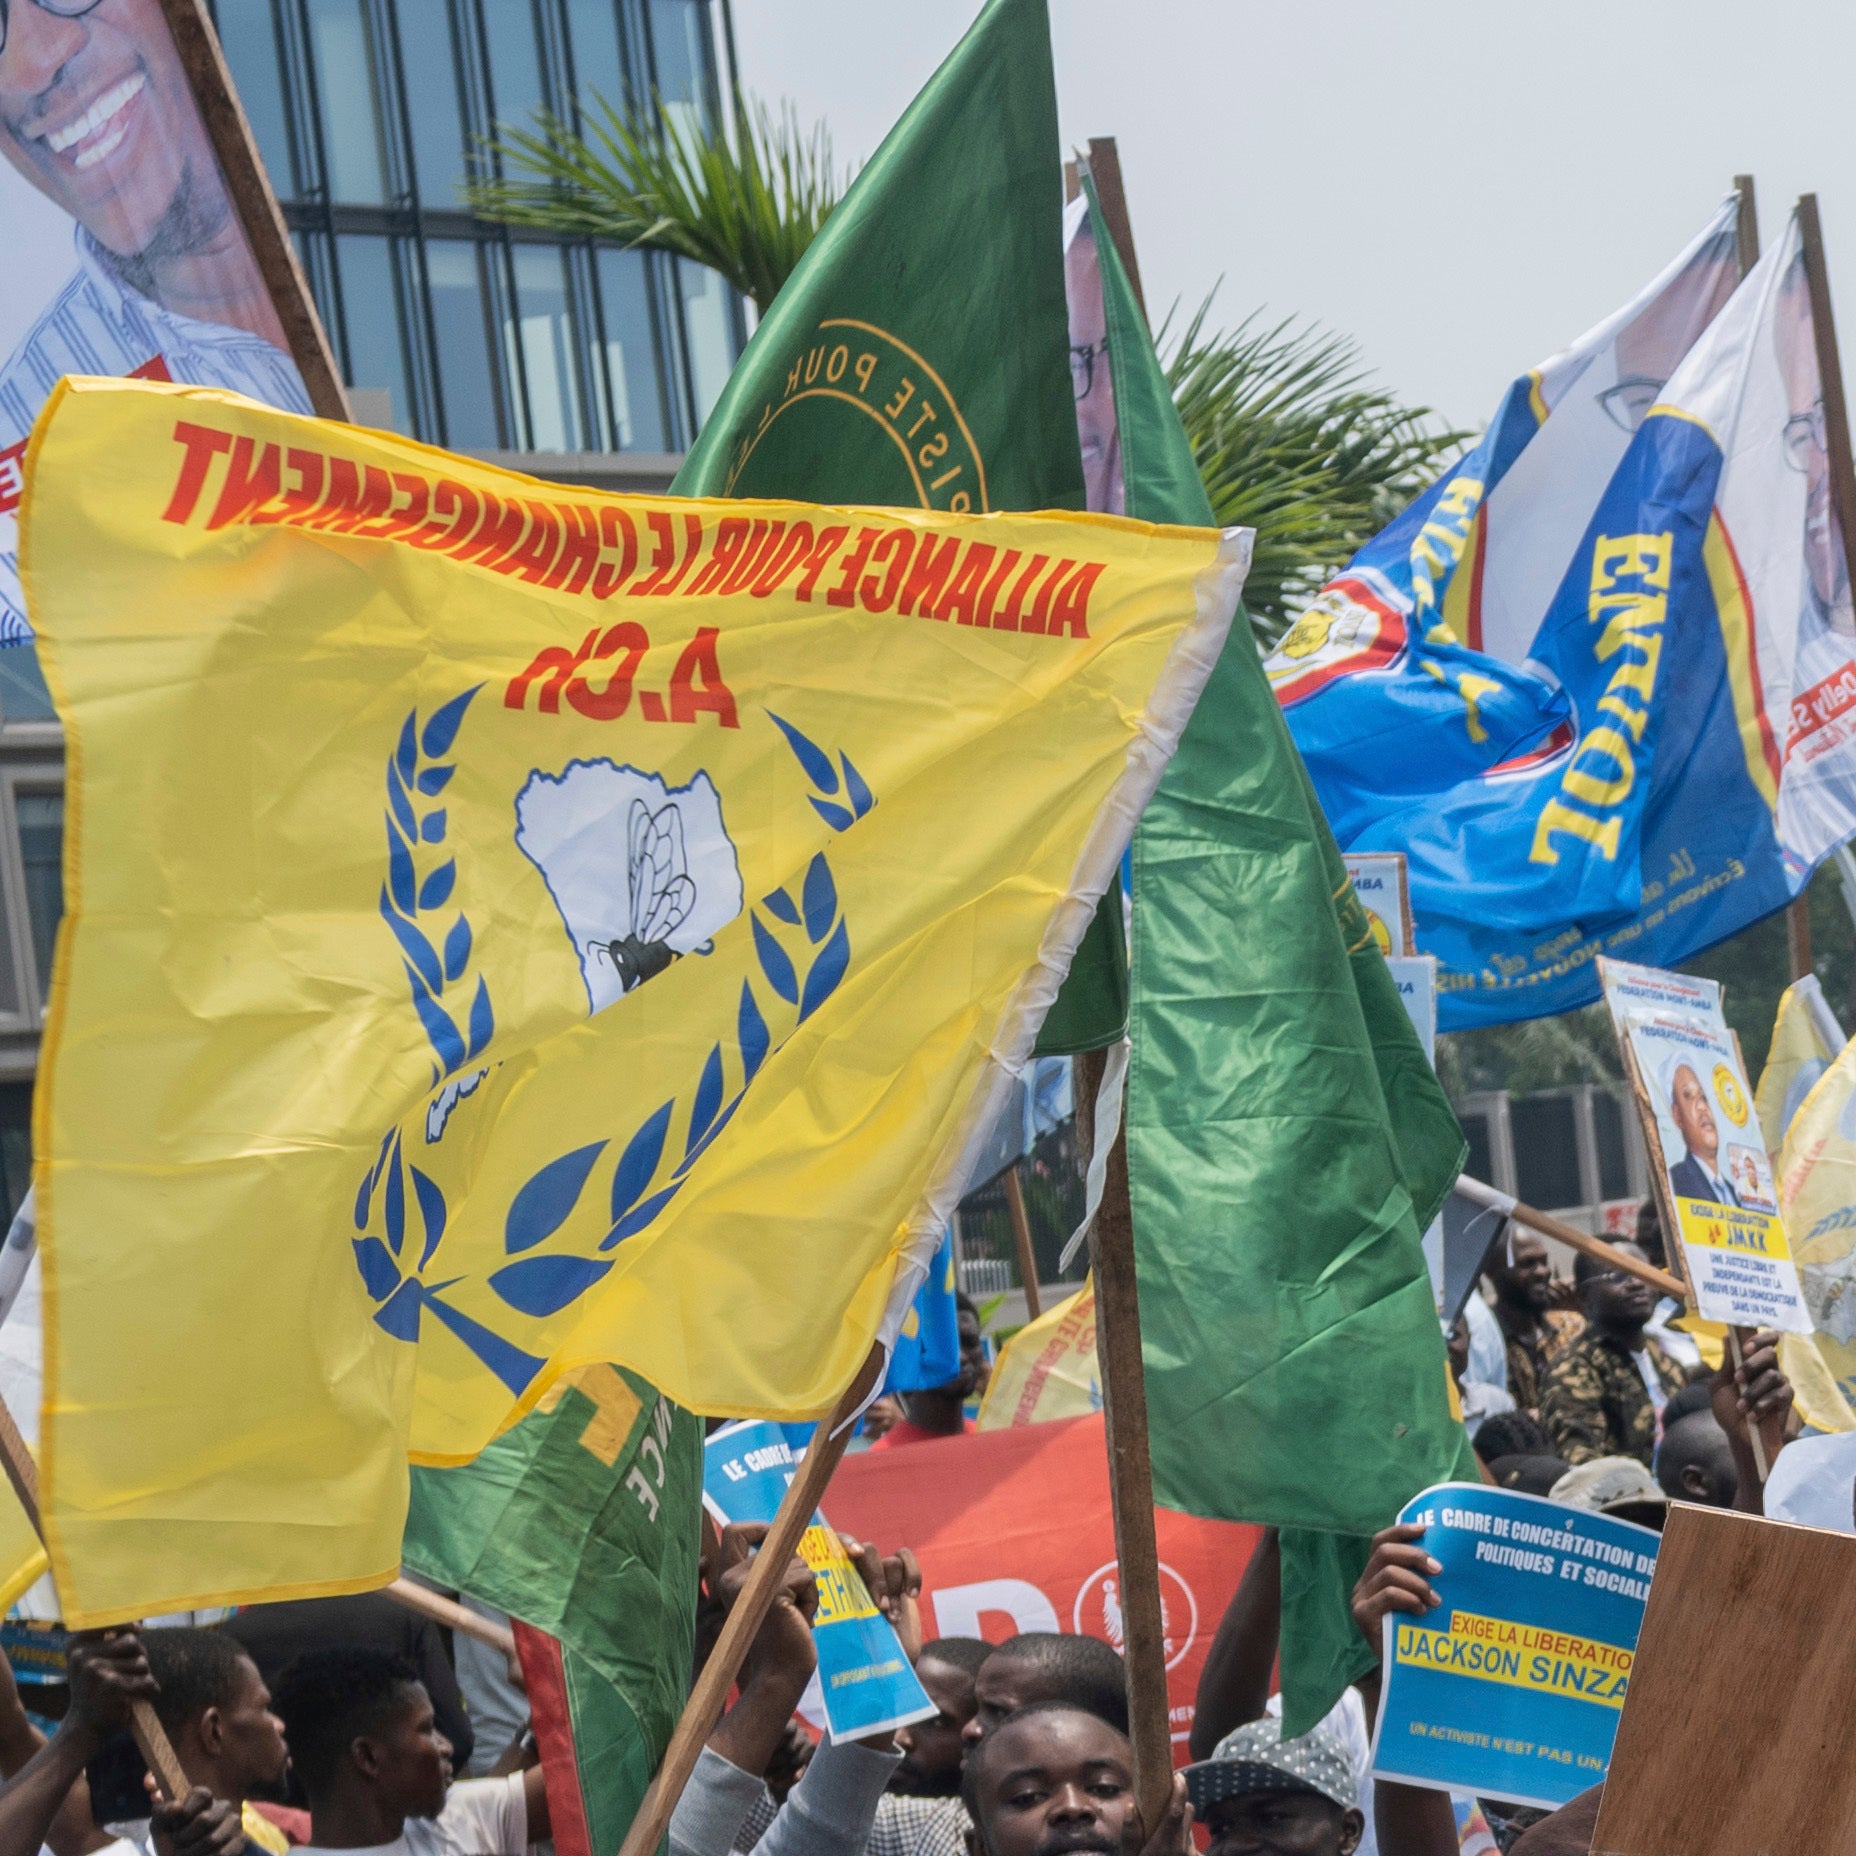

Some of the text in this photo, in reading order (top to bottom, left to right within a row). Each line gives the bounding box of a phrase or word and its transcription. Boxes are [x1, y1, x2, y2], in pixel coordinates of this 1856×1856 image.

[1441, 1507, 1492, 1535] CADRE
[1493, 1517, 1510, 1537] DE
[1511, 1522, 1634, 1569] CONCERTATION
[1475, 1541, 1583, 1582] POLITIQUES ET
[1399, 1629, 1521, 1678] JACKSON
[1452, 1614, 1632, 1671] EXIGE LA LIBERATIO
[1429, 1726, 1490, 1749] ACTIVISTE
[1493, 1737, 1532, 1756] N'EST
[1537, 1745, 1573, 1765] PAS
